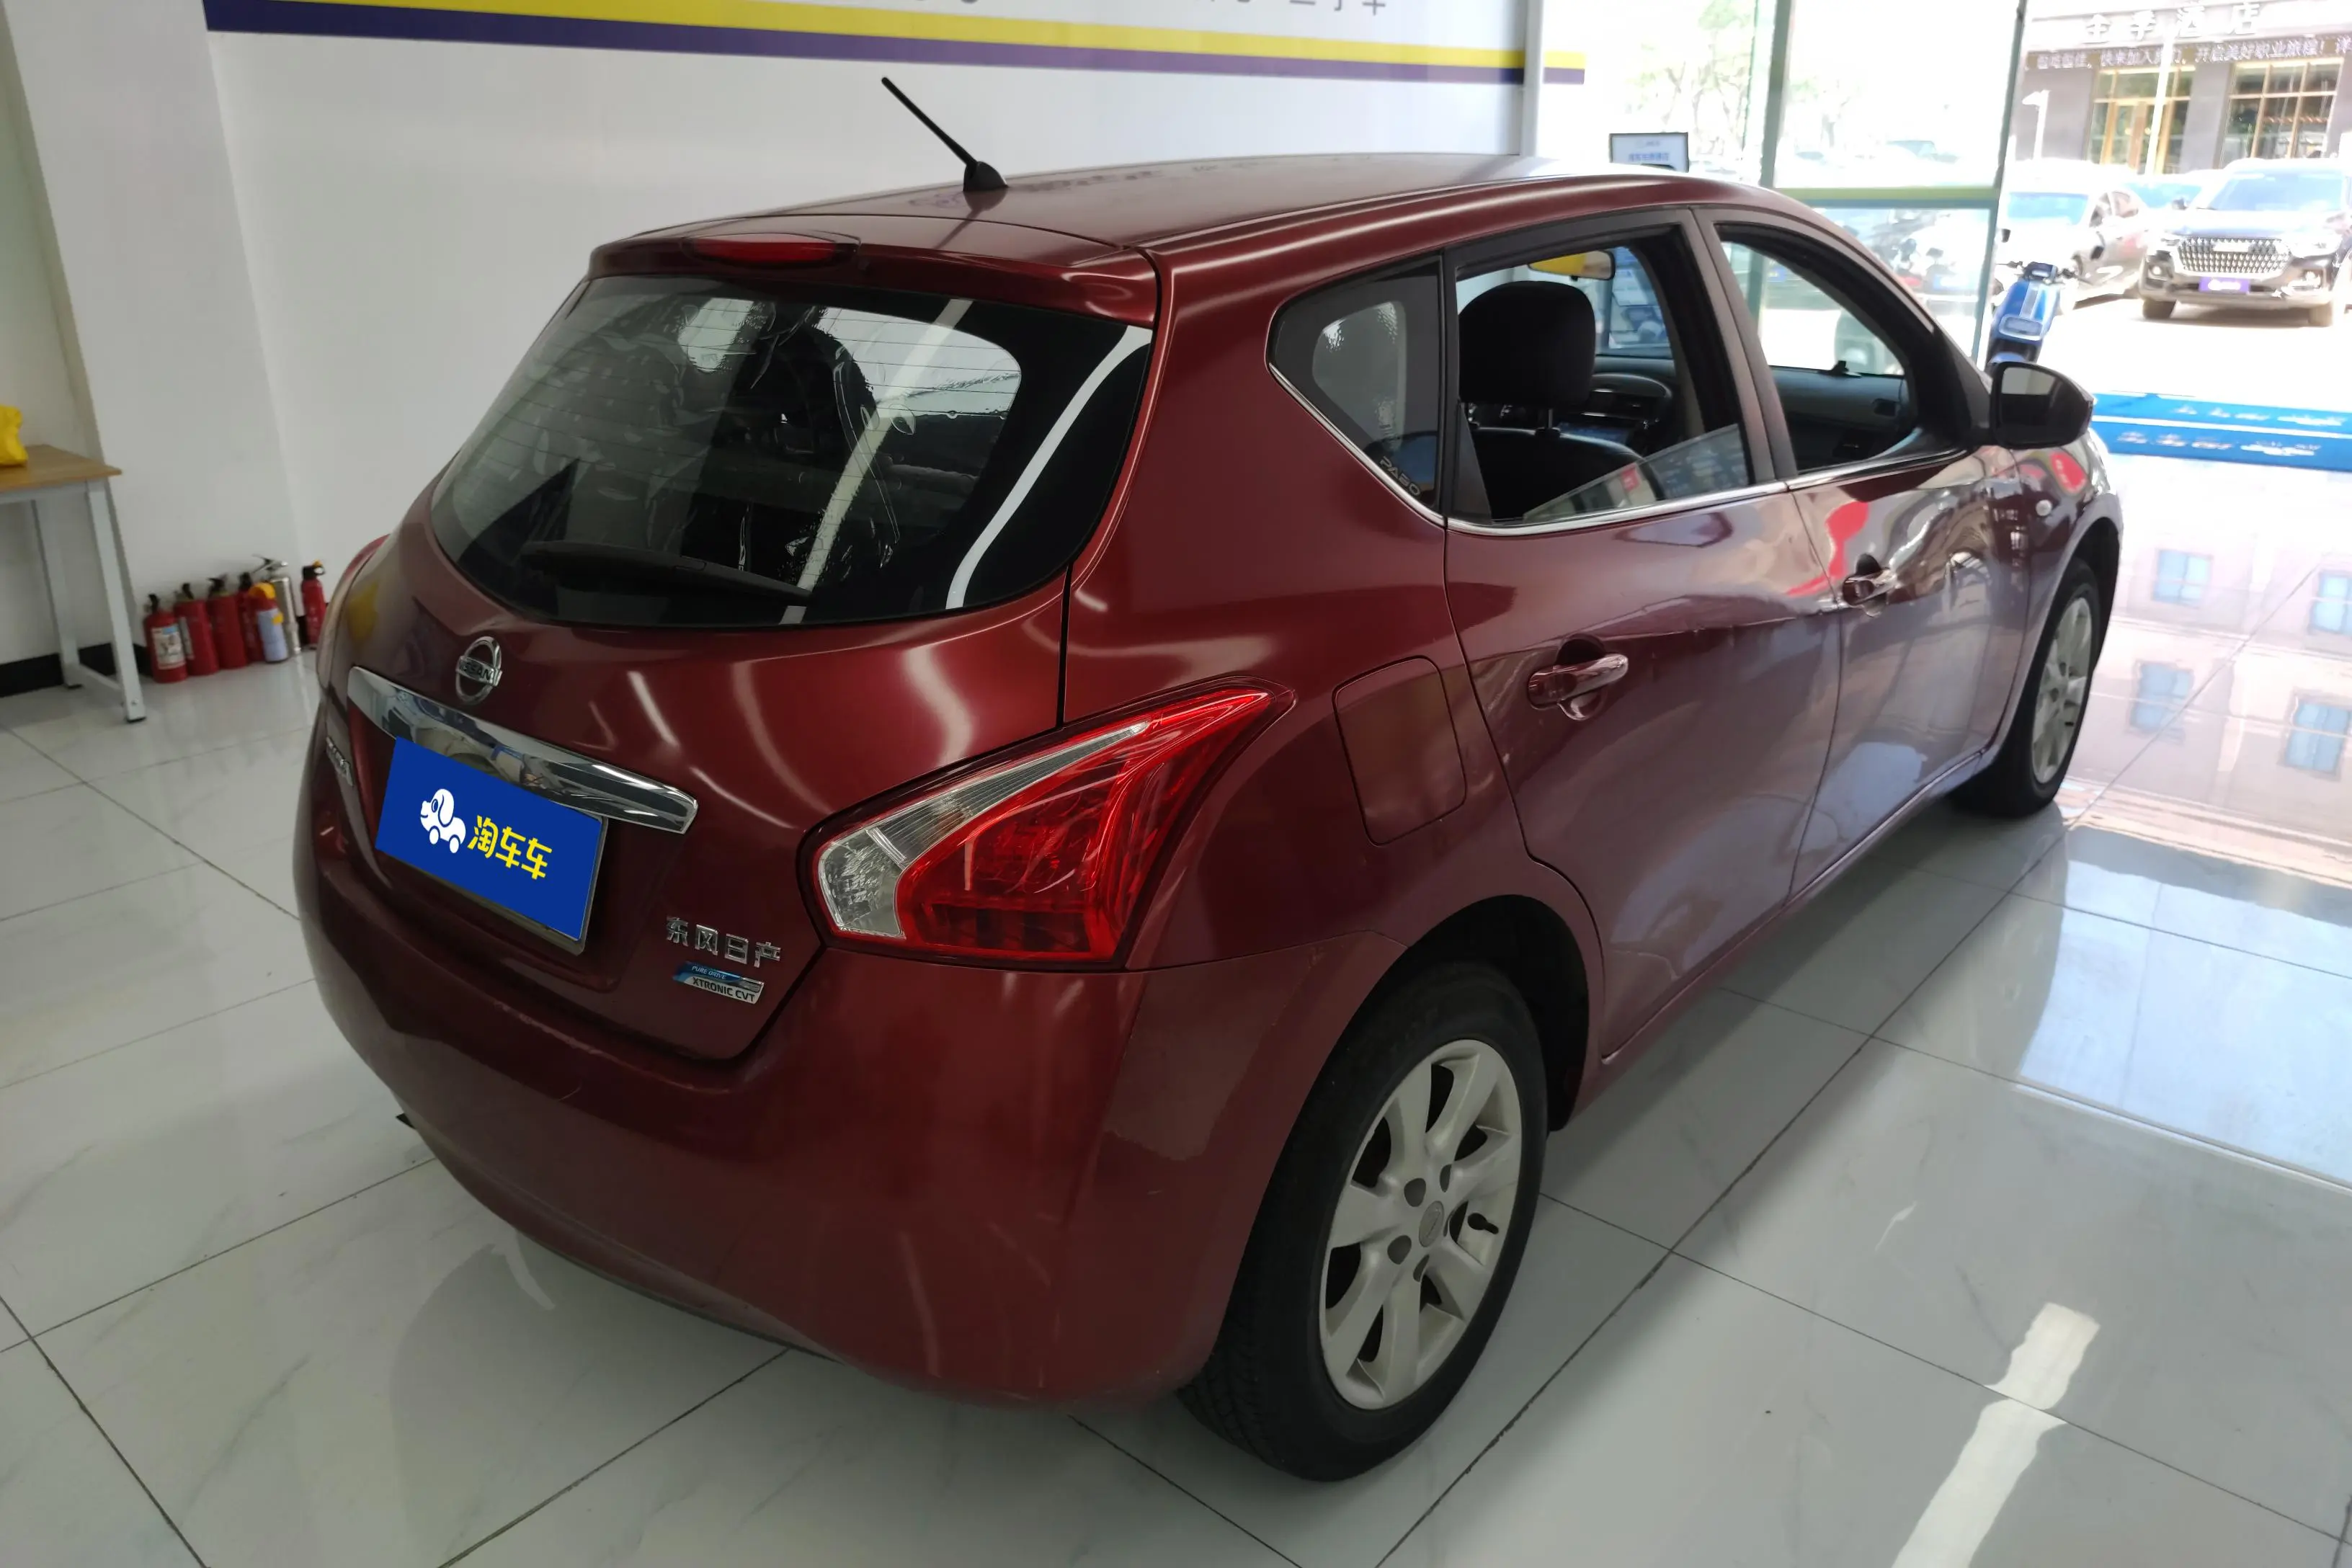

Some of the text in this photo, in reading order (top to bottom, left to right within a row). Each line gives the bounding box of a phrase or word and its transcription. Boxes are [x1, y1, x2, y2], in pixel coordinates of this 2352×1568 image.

[666, 916, 782, 968] 东风日产
[692, 966, 726, 979] PURE DRIVE
[692, 976, 755, 1002] XTRONIC CVT
